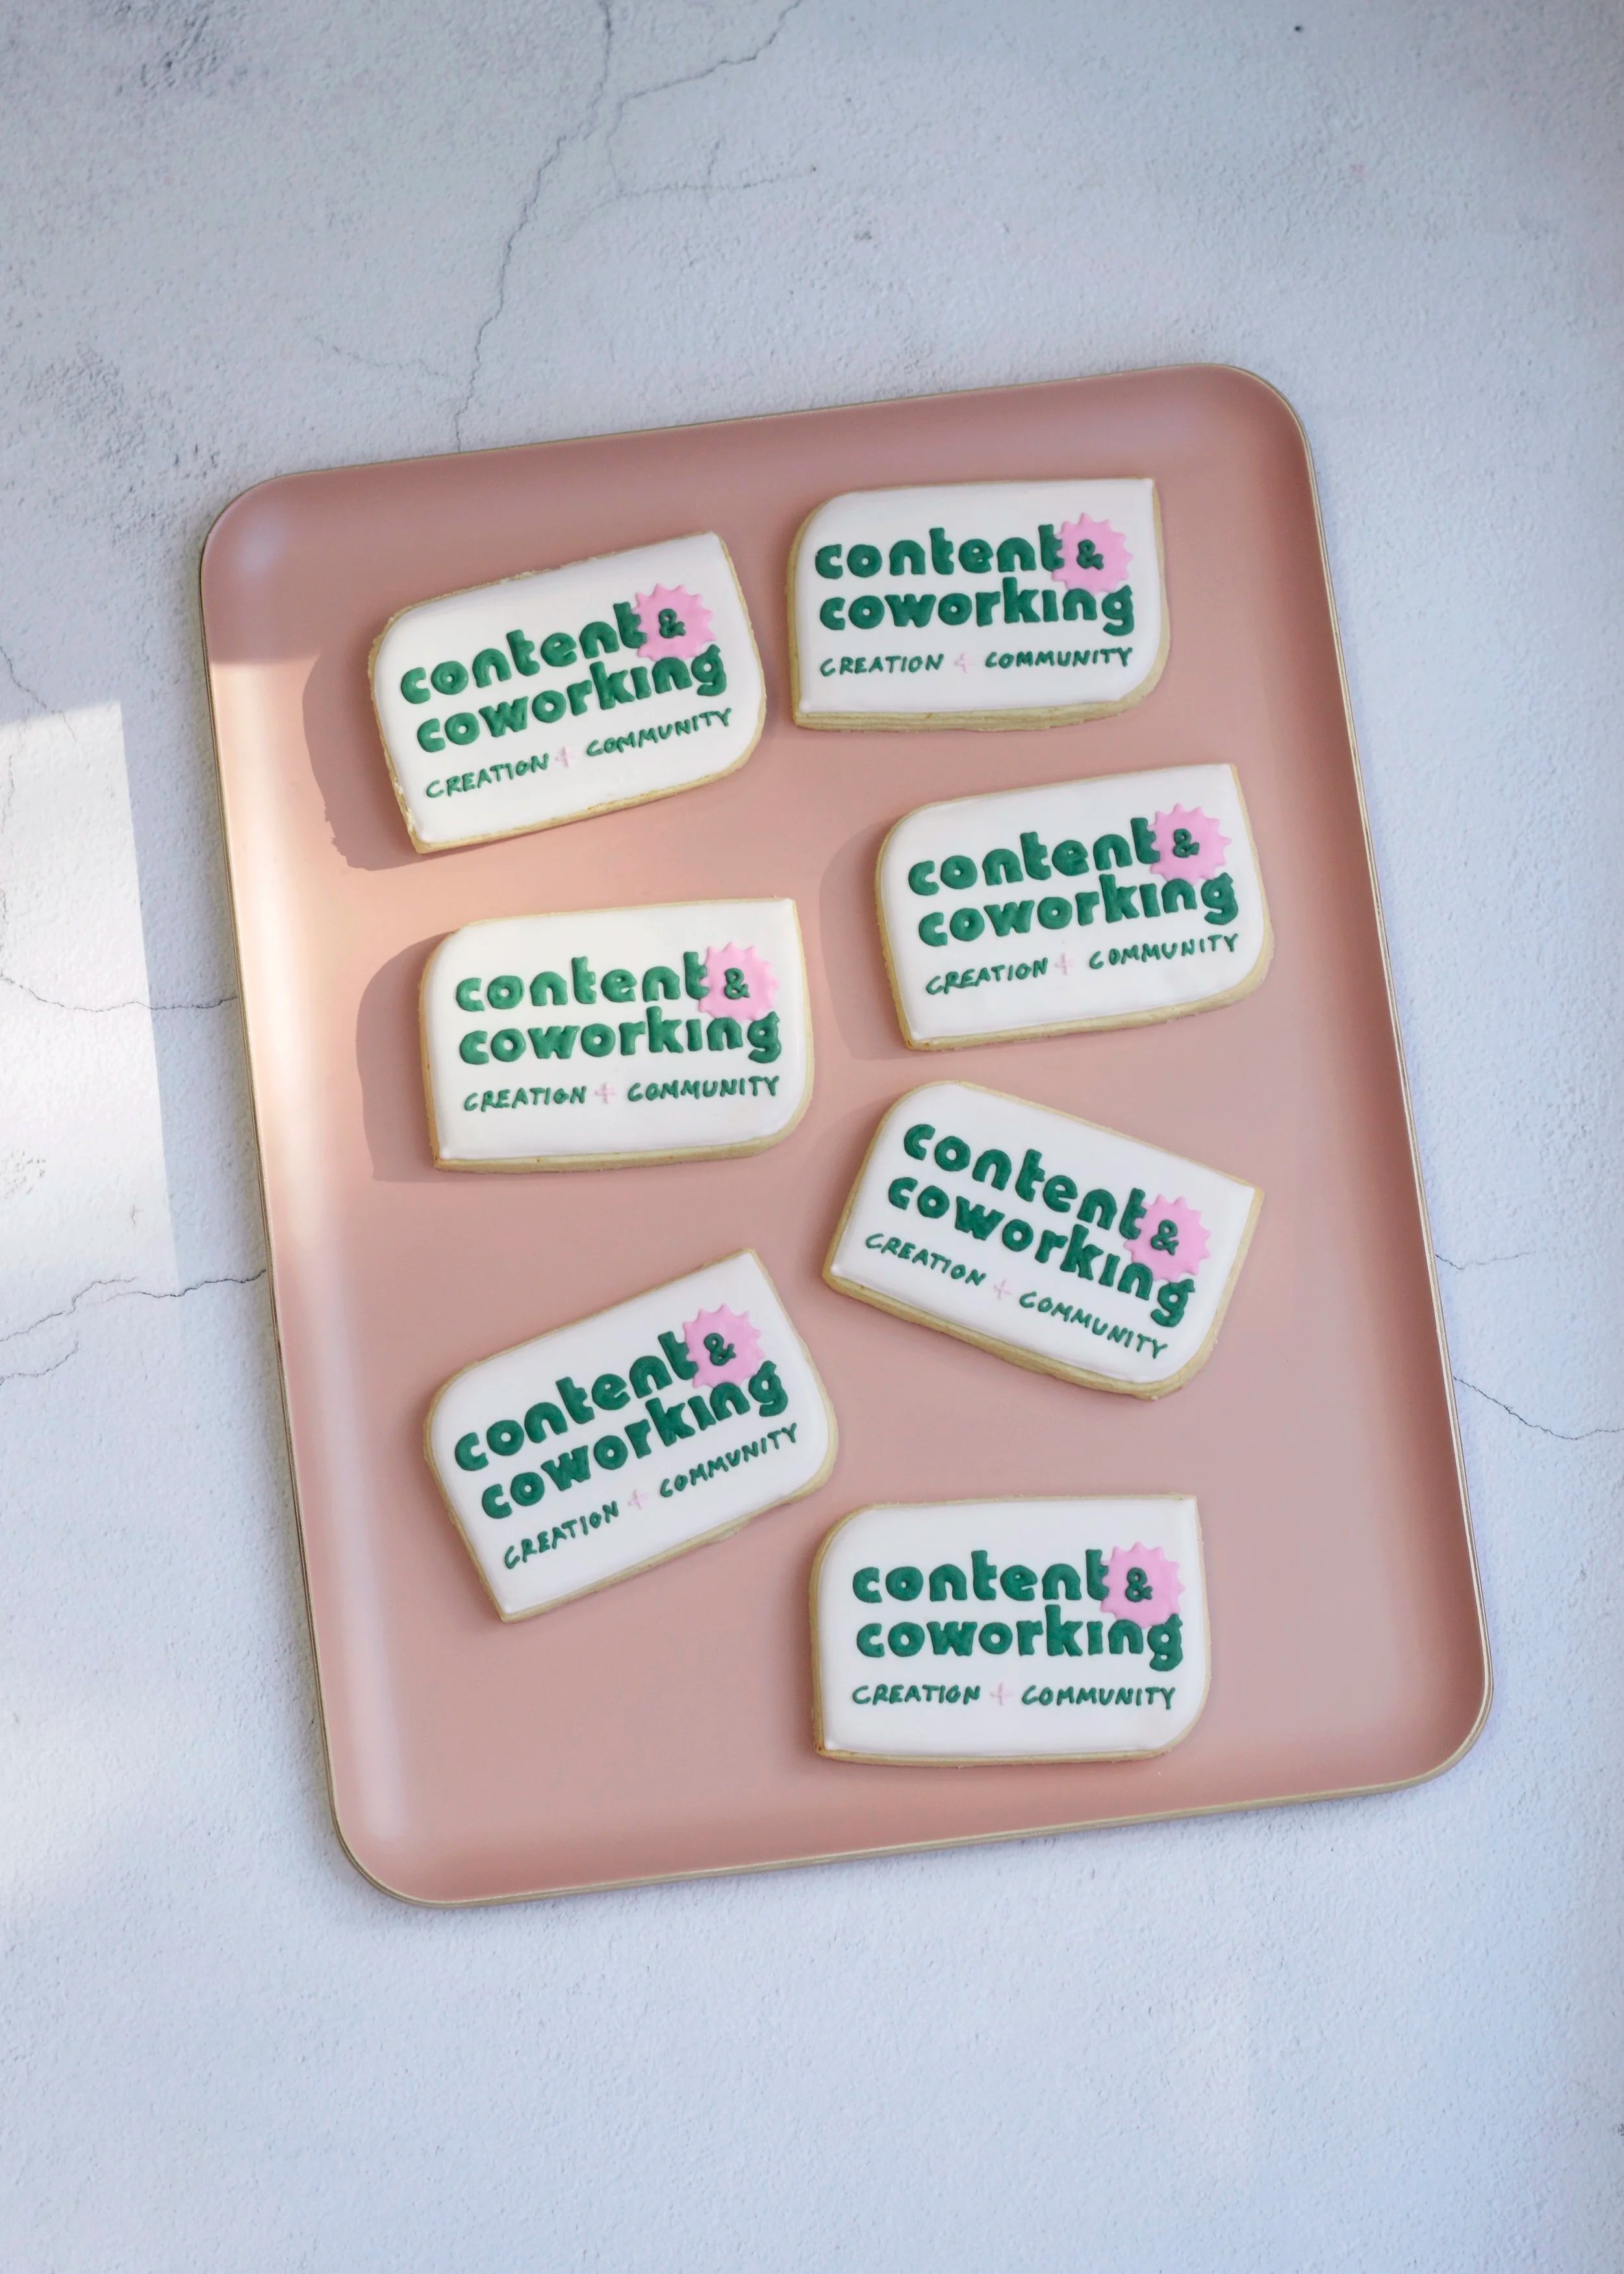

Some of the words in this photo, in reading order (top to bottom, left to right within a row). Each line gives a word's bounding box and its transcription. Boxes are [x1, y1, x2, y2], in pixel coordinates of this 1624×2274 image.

[814, 522, 1065, 580] content
[1076, 539, 1105, 570] &
[819, 575, 1136, 638] coworking
[400, 600, 648, 706] content
[657, 607, 686, 639] &
[820, 653, 945, 678] CREATION
[985, 646, 1134, 670] COMMUNITY
[416, 643, 728, 754] coworking
[425, 752, 550, 799] CREATION
[586, 706, 733, 757] COMMUNITY
[907, 816, 1161, 897] content
[1173, 827, 1201, 860] &
[918, 871, 1239, 948] coworking
[456, 951, 711, 1013] content
[724, 967, 751, 1001] &
[925, 956, 1049, 995] CREATION
[1088, 932, 1239, 971] COMMUNITY
[459, 1004, 783, 1066] coworking
[463, 1086, 588, 1114] CREATION
[626, 1075, 781, 1103] COMMUNITY
[903, 1123, 1148, 1240] content
[1150, 1218, 1180, 1255] &
[888, 1176, 1197, 1329] coworking
[865, 1233, 987, 1287] CREATION
[1019, 1290, 1169, 1361] COMMUNITY
[455, 1330, 699, 1472] content
[704, 1333, 737, 1366] &
[481, 1360, 789, 1520] coworking
[504, 1500, 620, 1569] CREATION
[659, 1422, 798, 1498] COMMUNITY
[852, 1548, 1110, 1605] content
[1125, 1566, 1154, 1603] &
[856, 1603, 1184, 1673] coworking
[852, 1683, 982, 1706] CREATION
[1021, 1684, 1176, 1711] COMMUNITY
